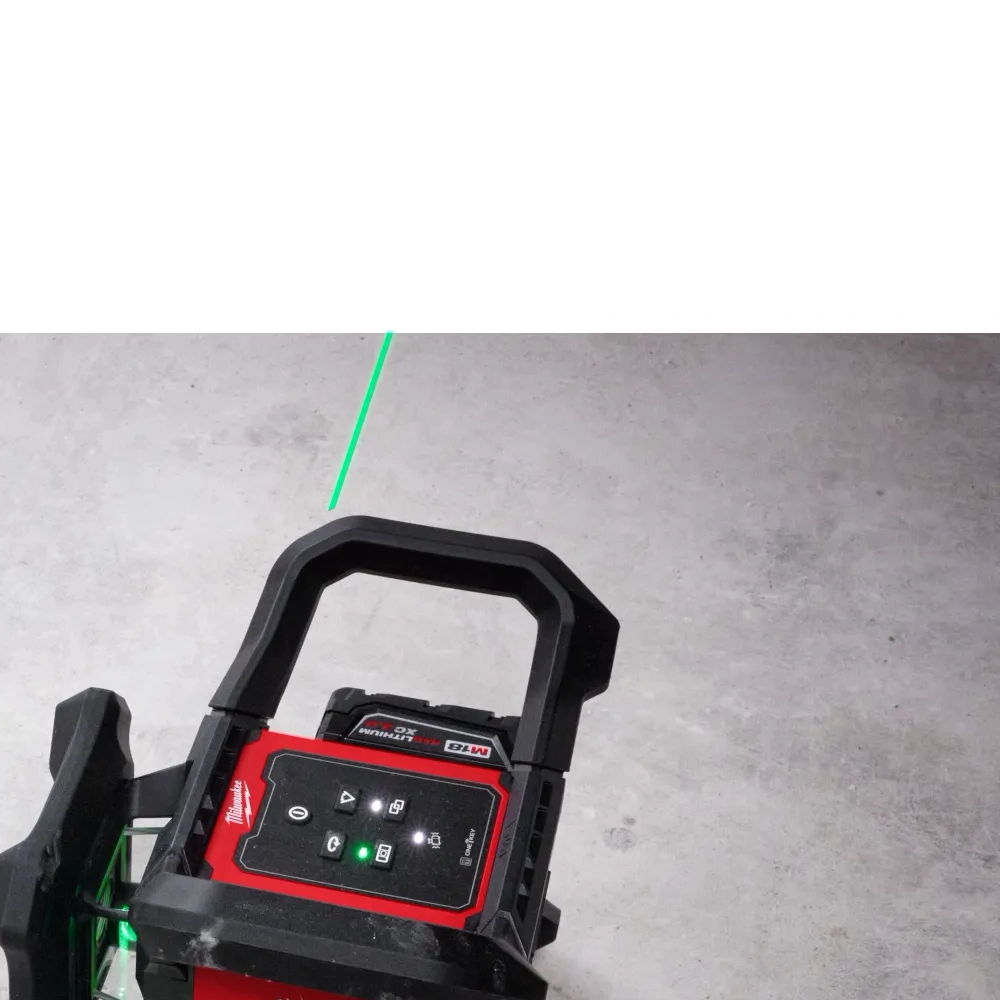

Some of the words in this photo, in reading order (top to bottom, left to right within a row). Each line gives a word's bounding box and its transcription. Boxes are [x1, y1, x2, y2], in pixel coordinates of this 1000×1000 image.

[393, 726, 418, 735] XC
[447, 742, 489, 756] M18
[224, 779, 244, 825] Milwaukee
